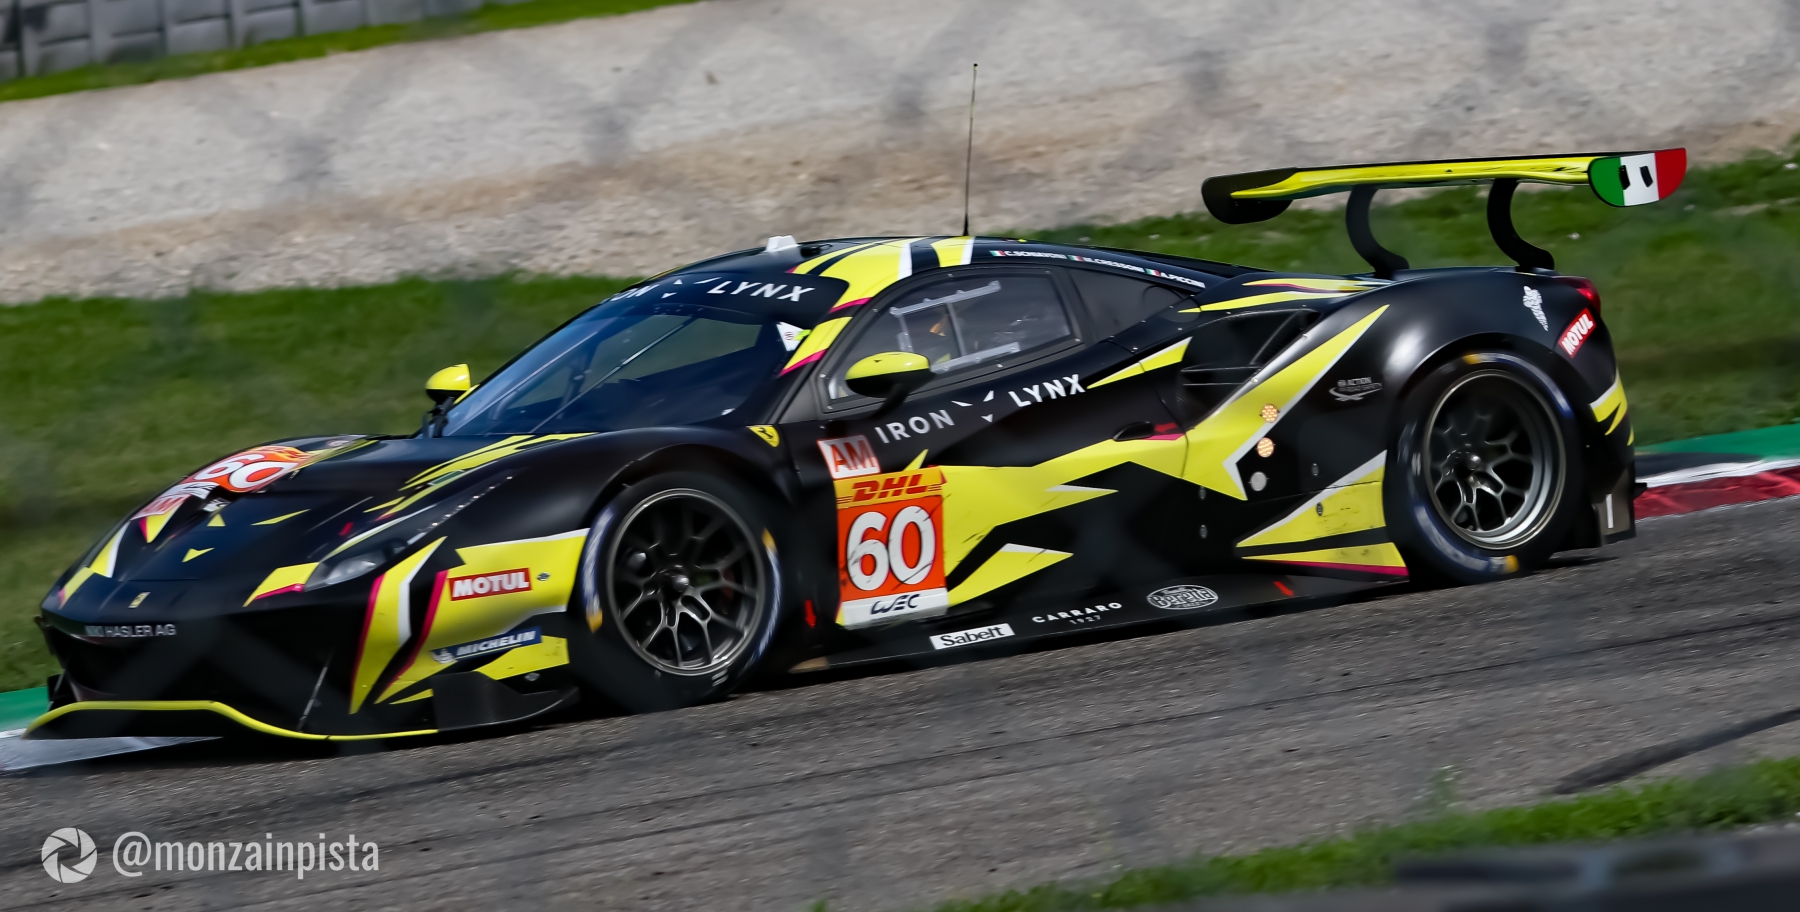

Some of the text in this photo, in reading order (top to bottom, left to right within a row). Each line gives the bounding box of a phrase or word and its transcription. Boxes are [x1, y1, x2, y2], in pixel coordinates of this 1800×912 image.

[706, 280, 815, 302] LYNX
[1561, 313, 1594, 355] MOTUL
[874, 374, 1085, 443] IRON LYNX
[830, 439, 878, 473] AM
[193, 453, 299, 489] 60
[852, 474, 928, 502] DHL
[847, 505, 936, 591] 60
[452, 571, 530, 598] MOTUL
[870, 593, 920, 615] WEC
[1031, 602, 1123, 623] CARRARO
[155, 623, 177, 636] AG
[456, 630, 537, 656] MICHELIN
[940, 625, 1004, 647] Sabelt
